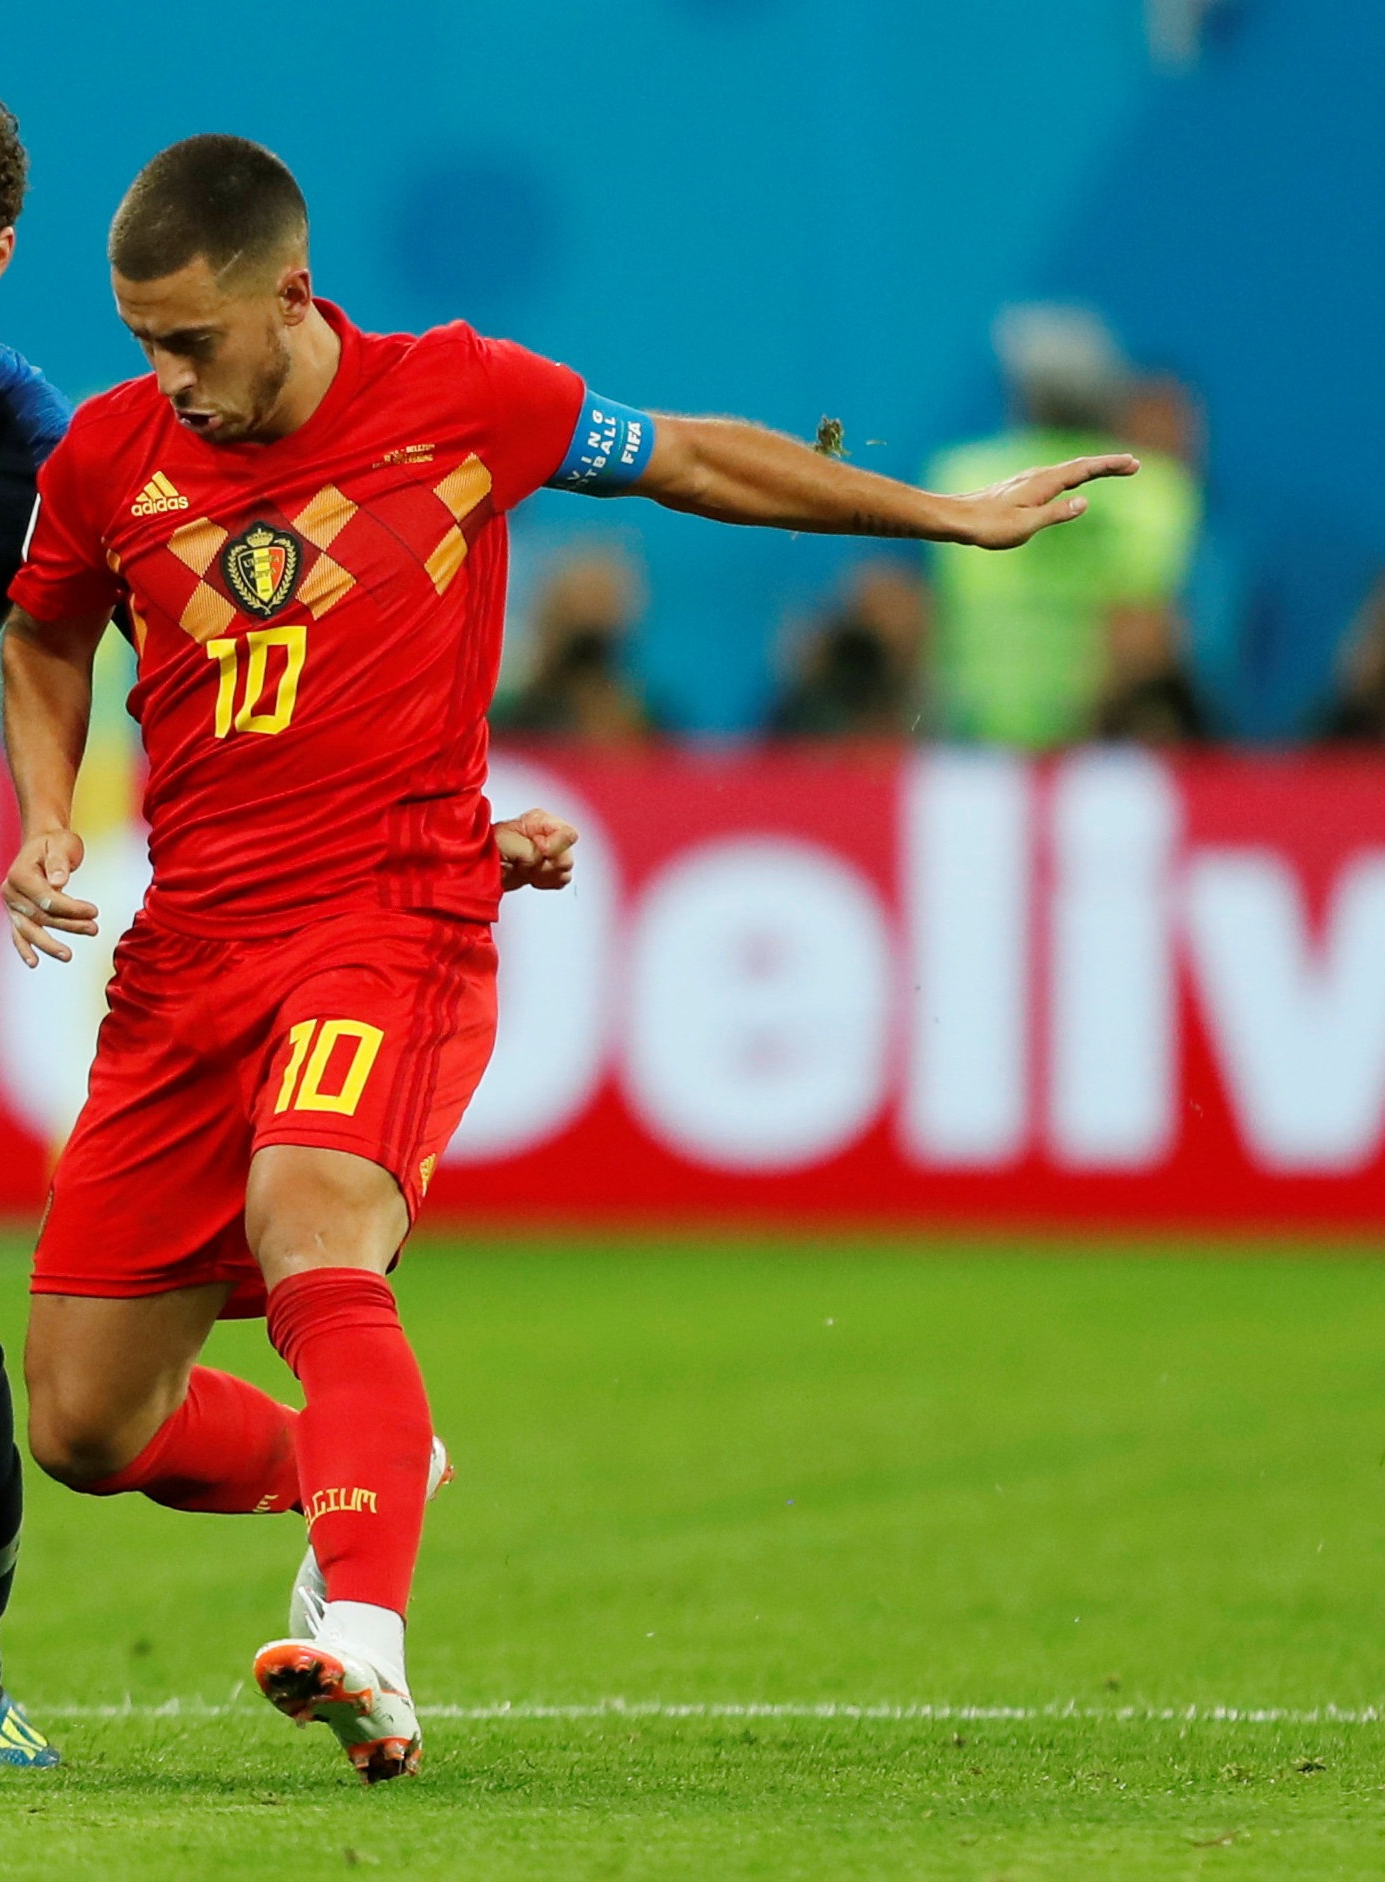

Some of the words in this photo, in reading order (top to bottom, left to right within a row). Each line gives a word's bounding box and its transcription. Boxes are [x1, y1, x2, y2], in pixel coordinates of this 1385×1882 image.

[620, 421, 642, 465] FIFA
[131, 495, 189, 517] adidas
[206, 625, 307, 739] 10
[274, 1018, 385, 1117] 10
